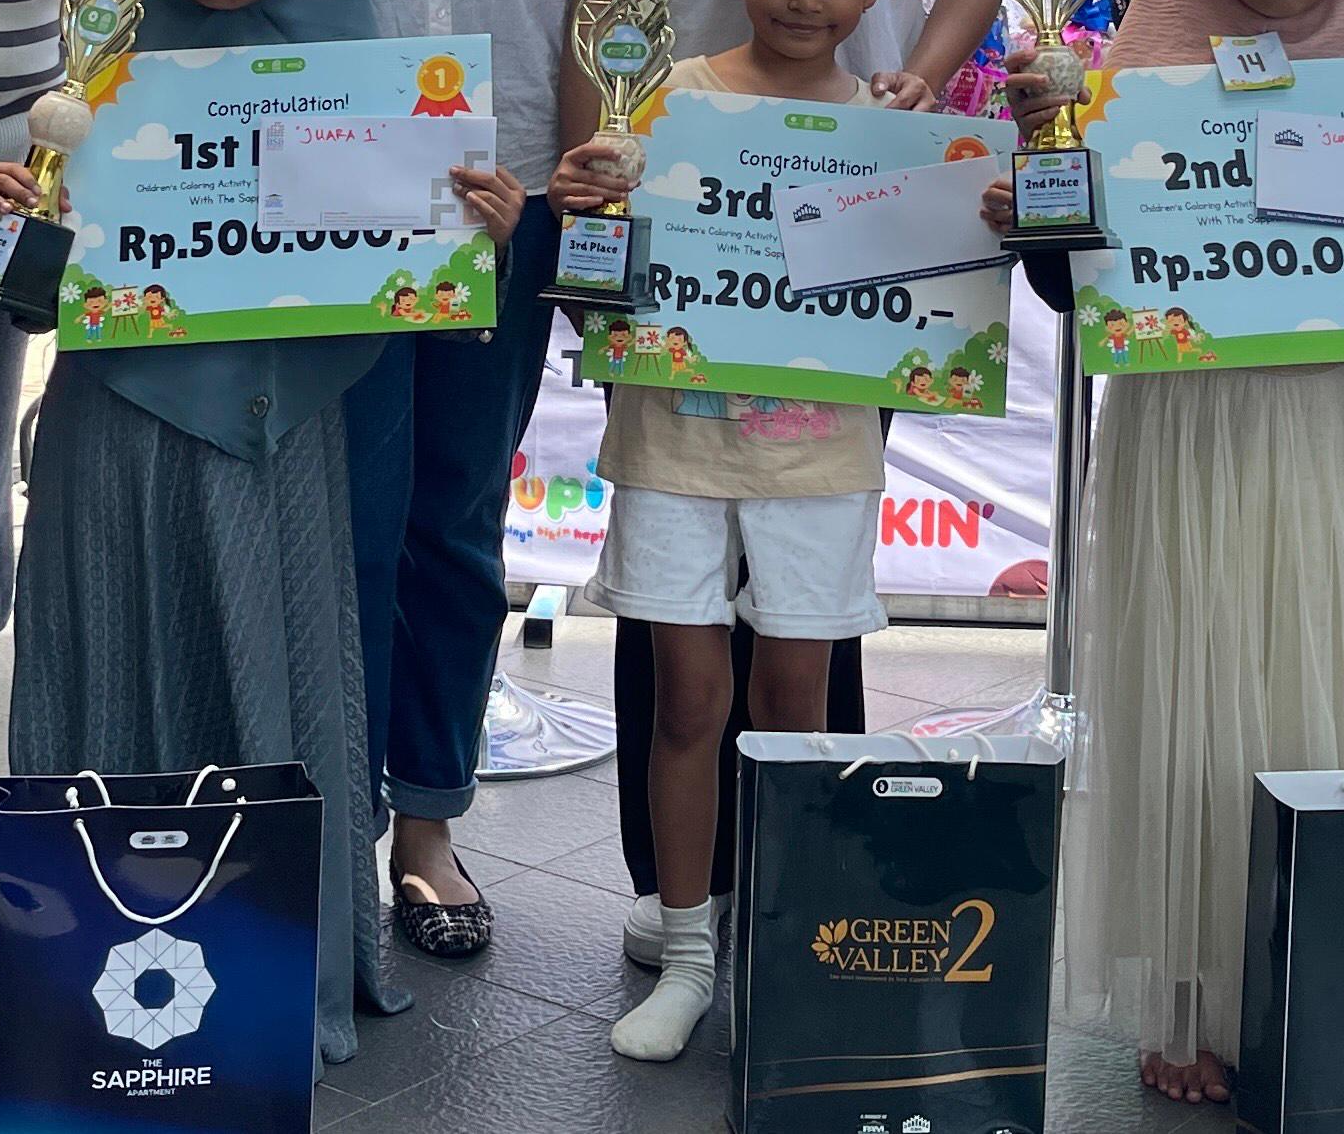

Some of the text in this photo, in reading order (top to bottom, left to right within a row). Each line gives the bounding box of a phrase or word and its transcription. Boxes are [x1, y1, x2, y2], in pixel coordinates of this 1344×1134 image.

[1236, 51, 1266, 74] 14
[433, 66, 446, 89] 1
[207, 93, 349, 125] Congratulation!
[174, 132, 239, 171] 1st
[1161, 148, 1252, 191] 2nd
[136, 177, 251, 193] Children's Coloring Activity
[1024, 177, 1080, 190] 2nd Place
[189, 194, 214, 206] With
[217, 193, 236, 205] The
[696, 176, 773, 221] 3rd
[1139, 202, 1183, 214] Children's
[1184, 200, 1221, 213] Coloring
[1196, 214, 1245, 226] With The
[665, 222, 778, 243] Children's Coloring Activity
[569, 239, 618, 255] 3rd Place
[716, 242, 740, 255] With
[743, 244, 761, 256] The
[850, 918, 952, 944] GREEN
[944, 898, 996, 982] 2
[832, 947, 948, 972] VALLEY
[141, 1058, 163, 1068] THE
[91, 1066, 212, 1090] SAPPHIRE
[126, 1088, 176, 1097] APARTMENT
